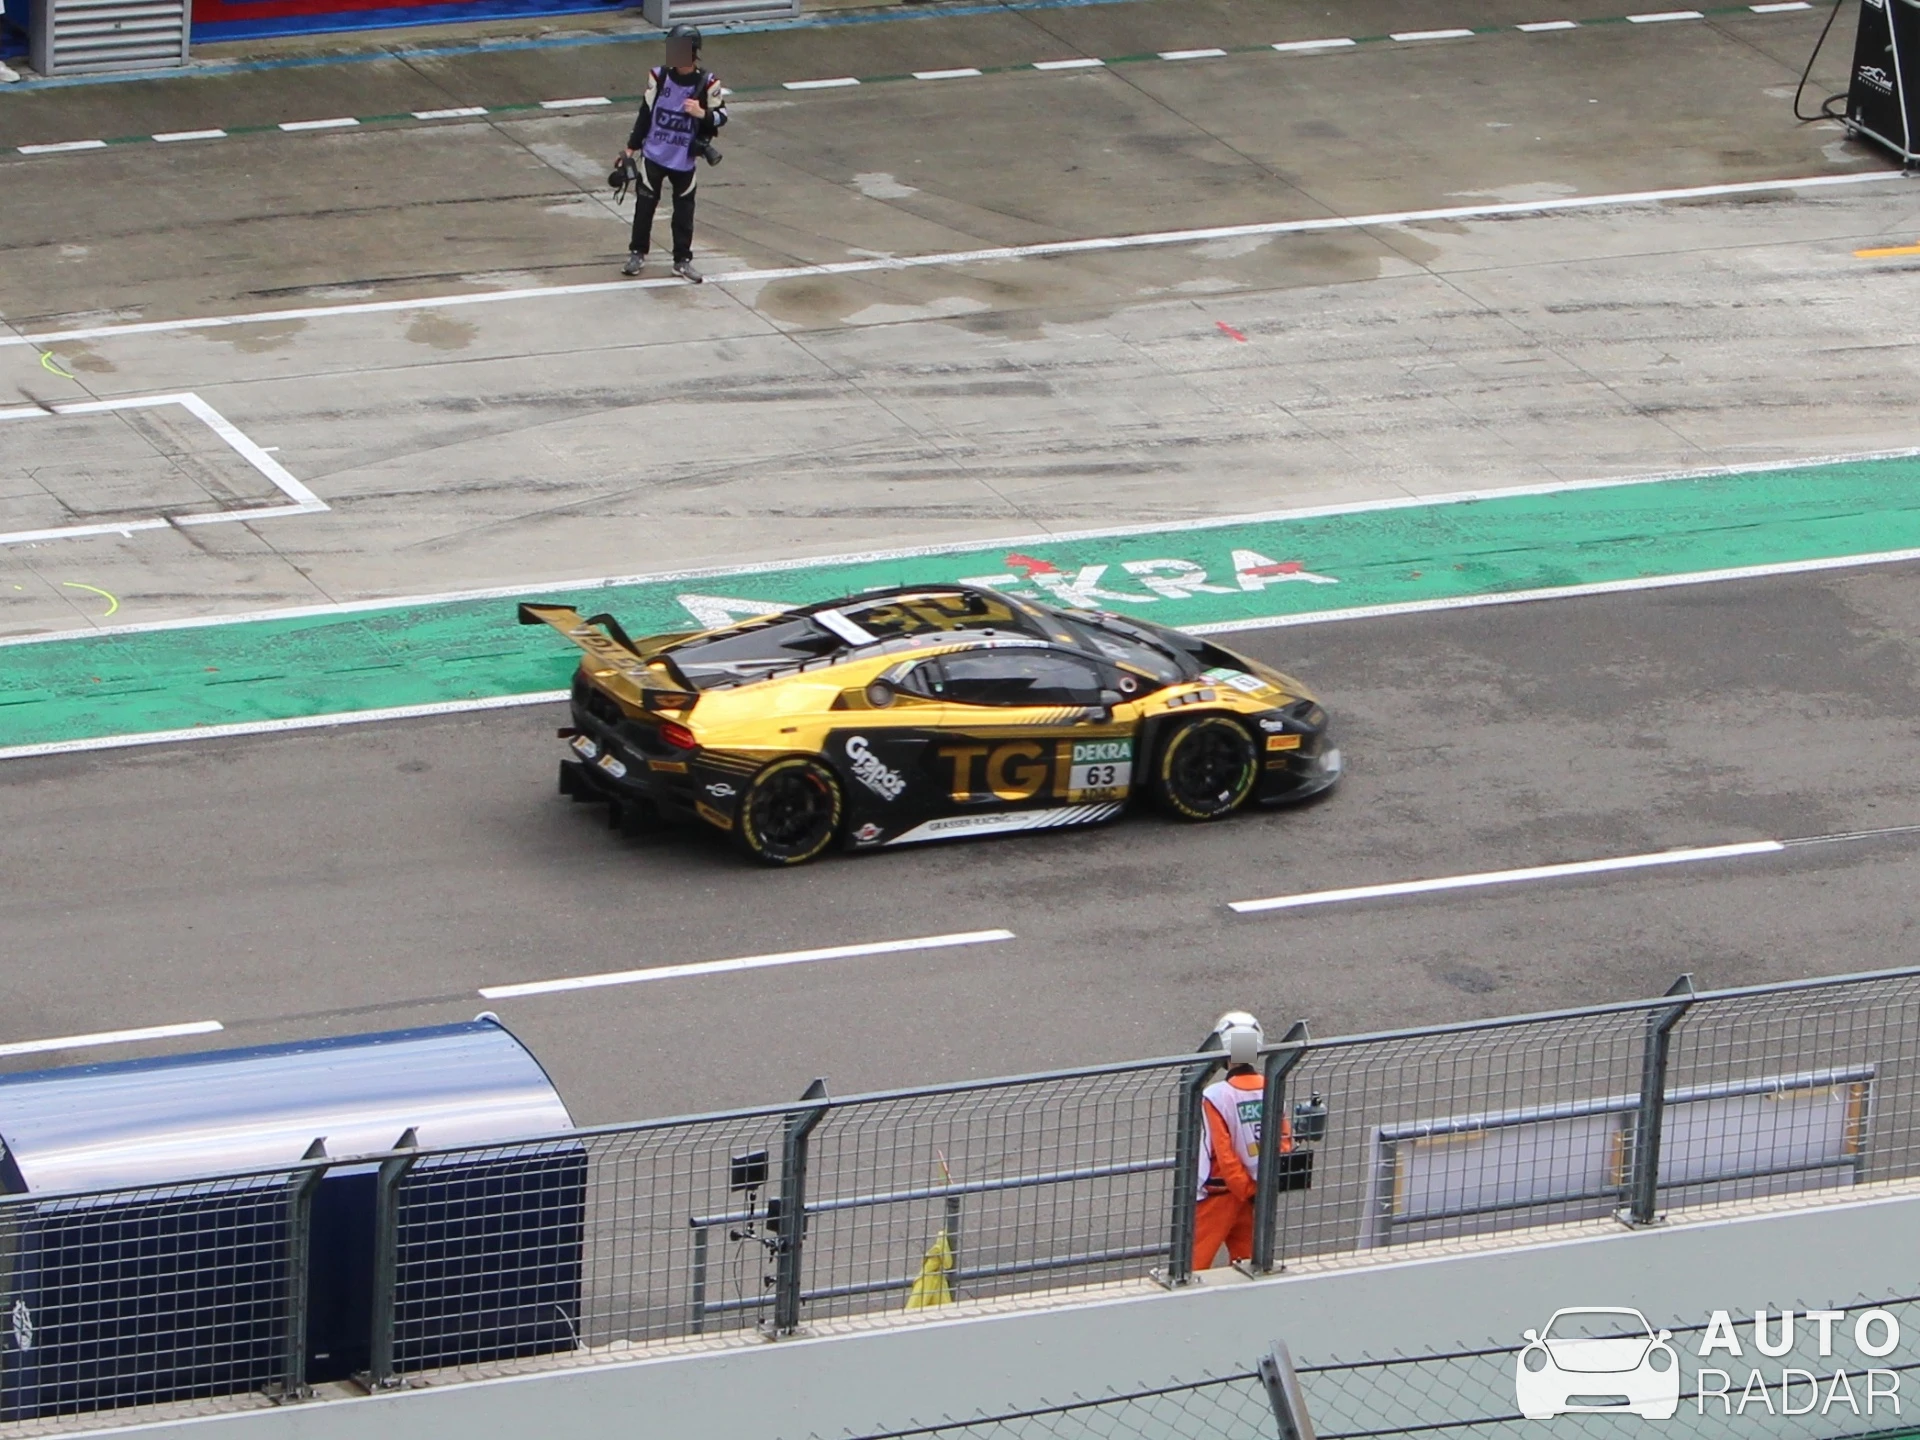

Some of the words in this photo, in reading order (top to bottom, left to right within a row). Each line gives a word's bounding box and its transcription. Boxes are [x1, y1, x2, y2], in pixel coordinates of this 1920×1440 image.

[658, 112, 692, 130] DTM
[1073, 742, 1132, 761] DEKRA
[1087, 765, 1115, 785] 63
